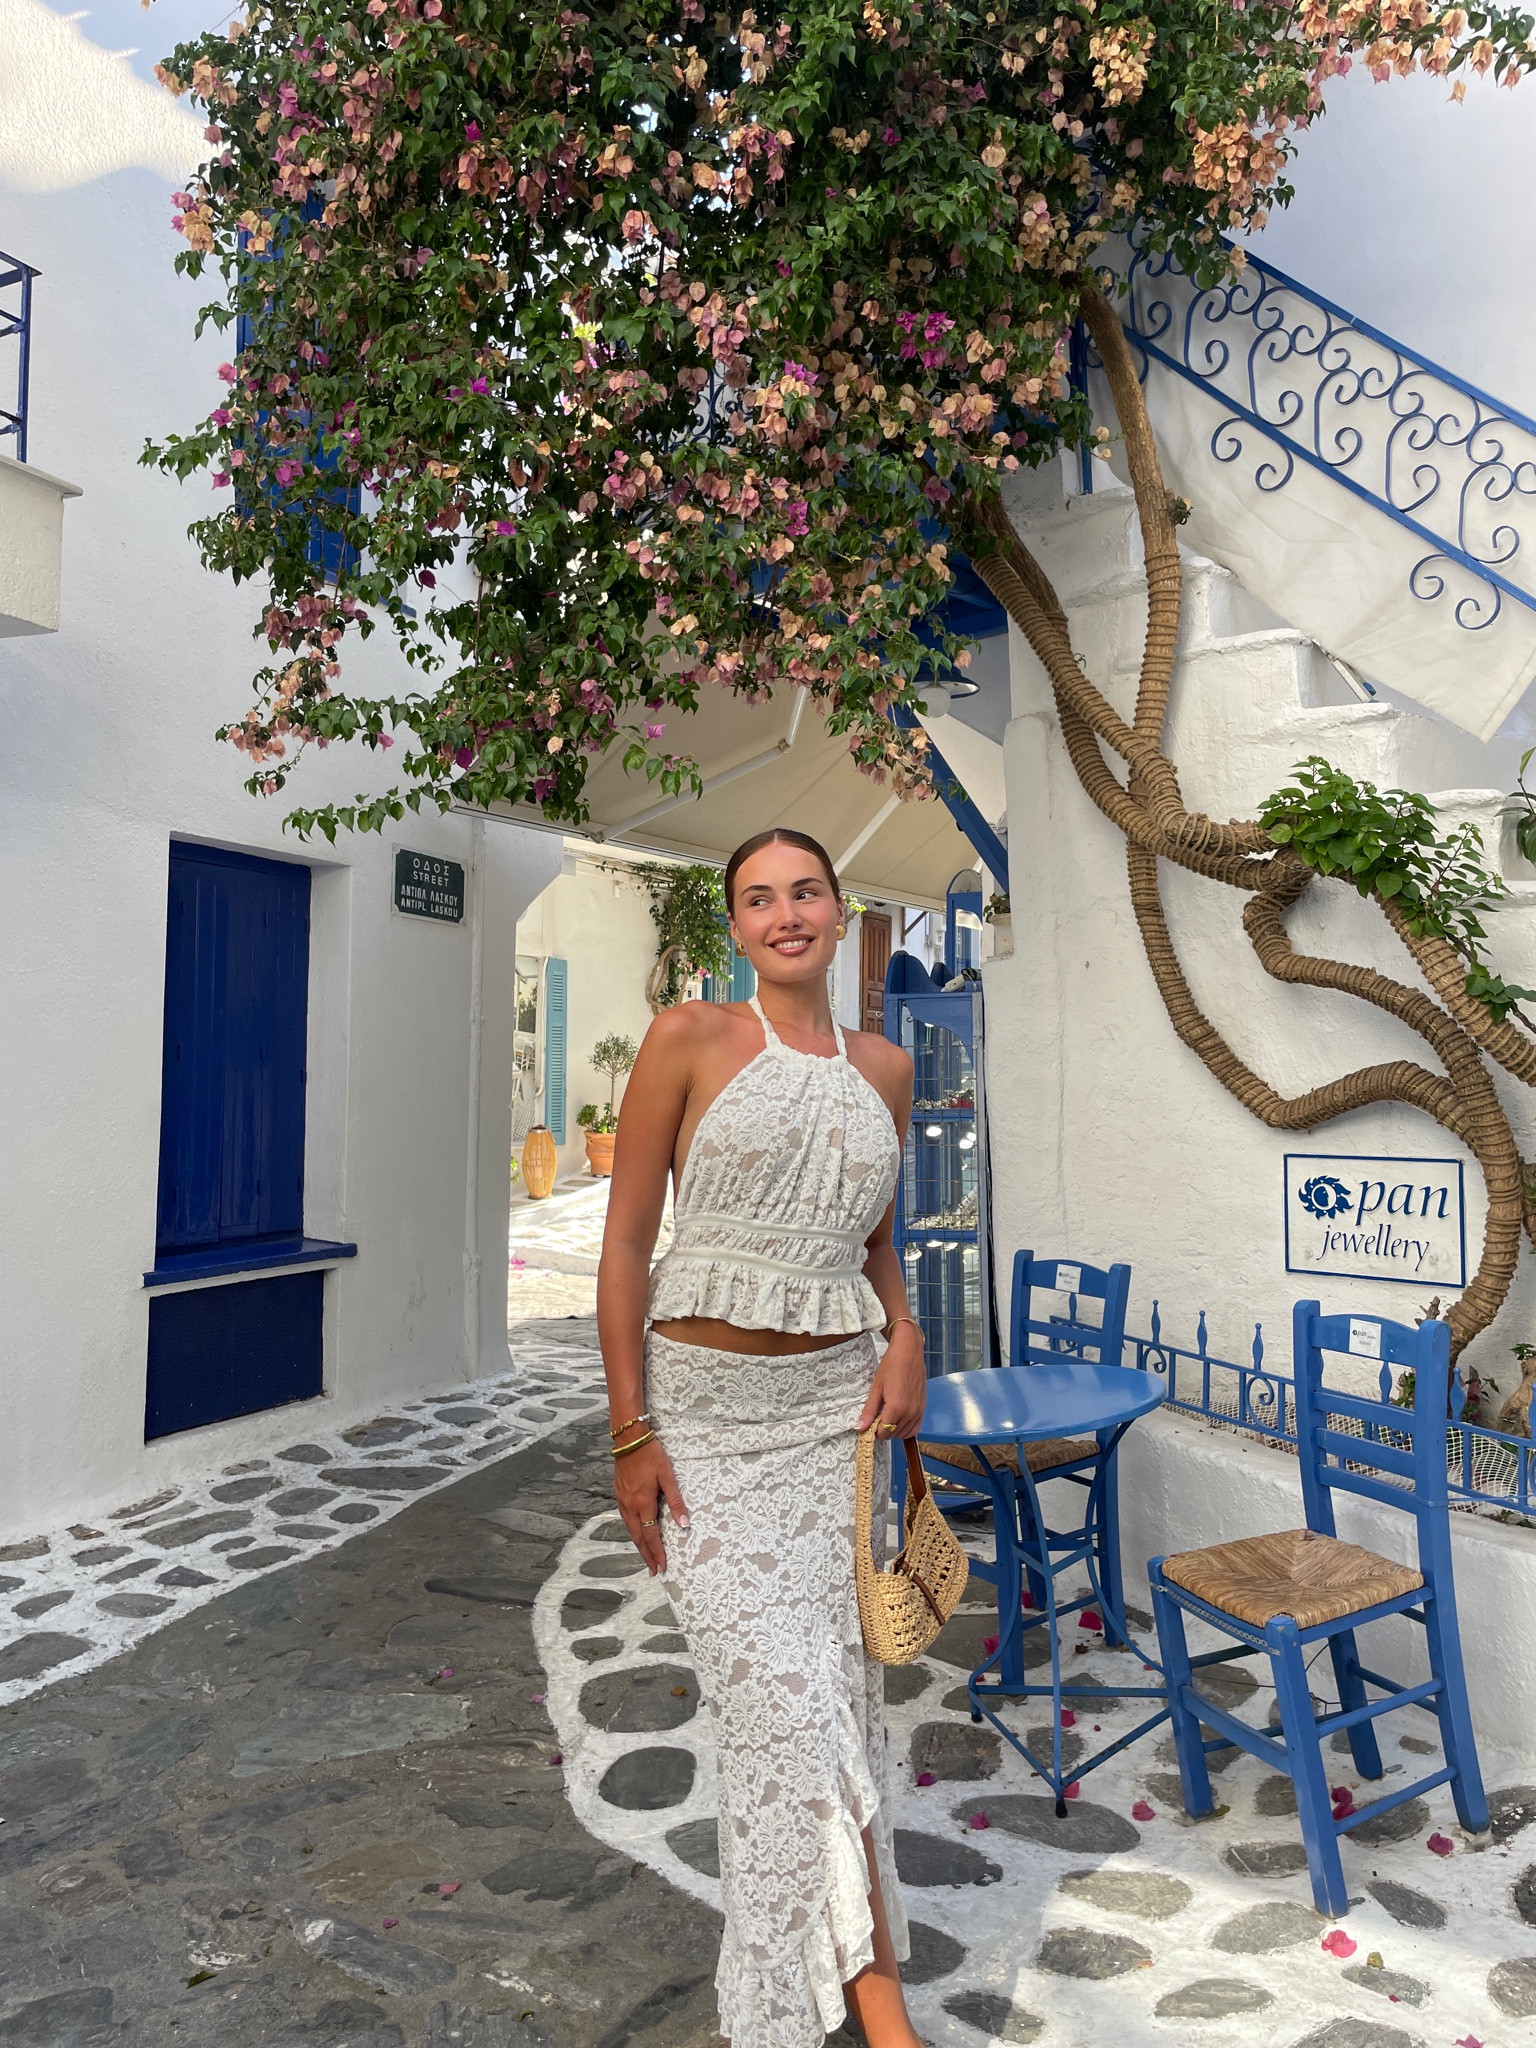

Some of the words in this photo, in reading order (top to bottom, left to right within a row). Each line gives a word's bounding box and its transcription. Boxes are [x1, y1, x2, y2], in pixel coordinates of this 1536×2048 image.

[413, 858, 449, 876] ΟΔΟΣ
[413, 870, 449, 887] STREET
[430, 890, 458, 907] ΛΑΣΚΟΥ
[430, 904, 458, 918] LASKOU
[1315, 1224, 1430, 1272] jewellery
